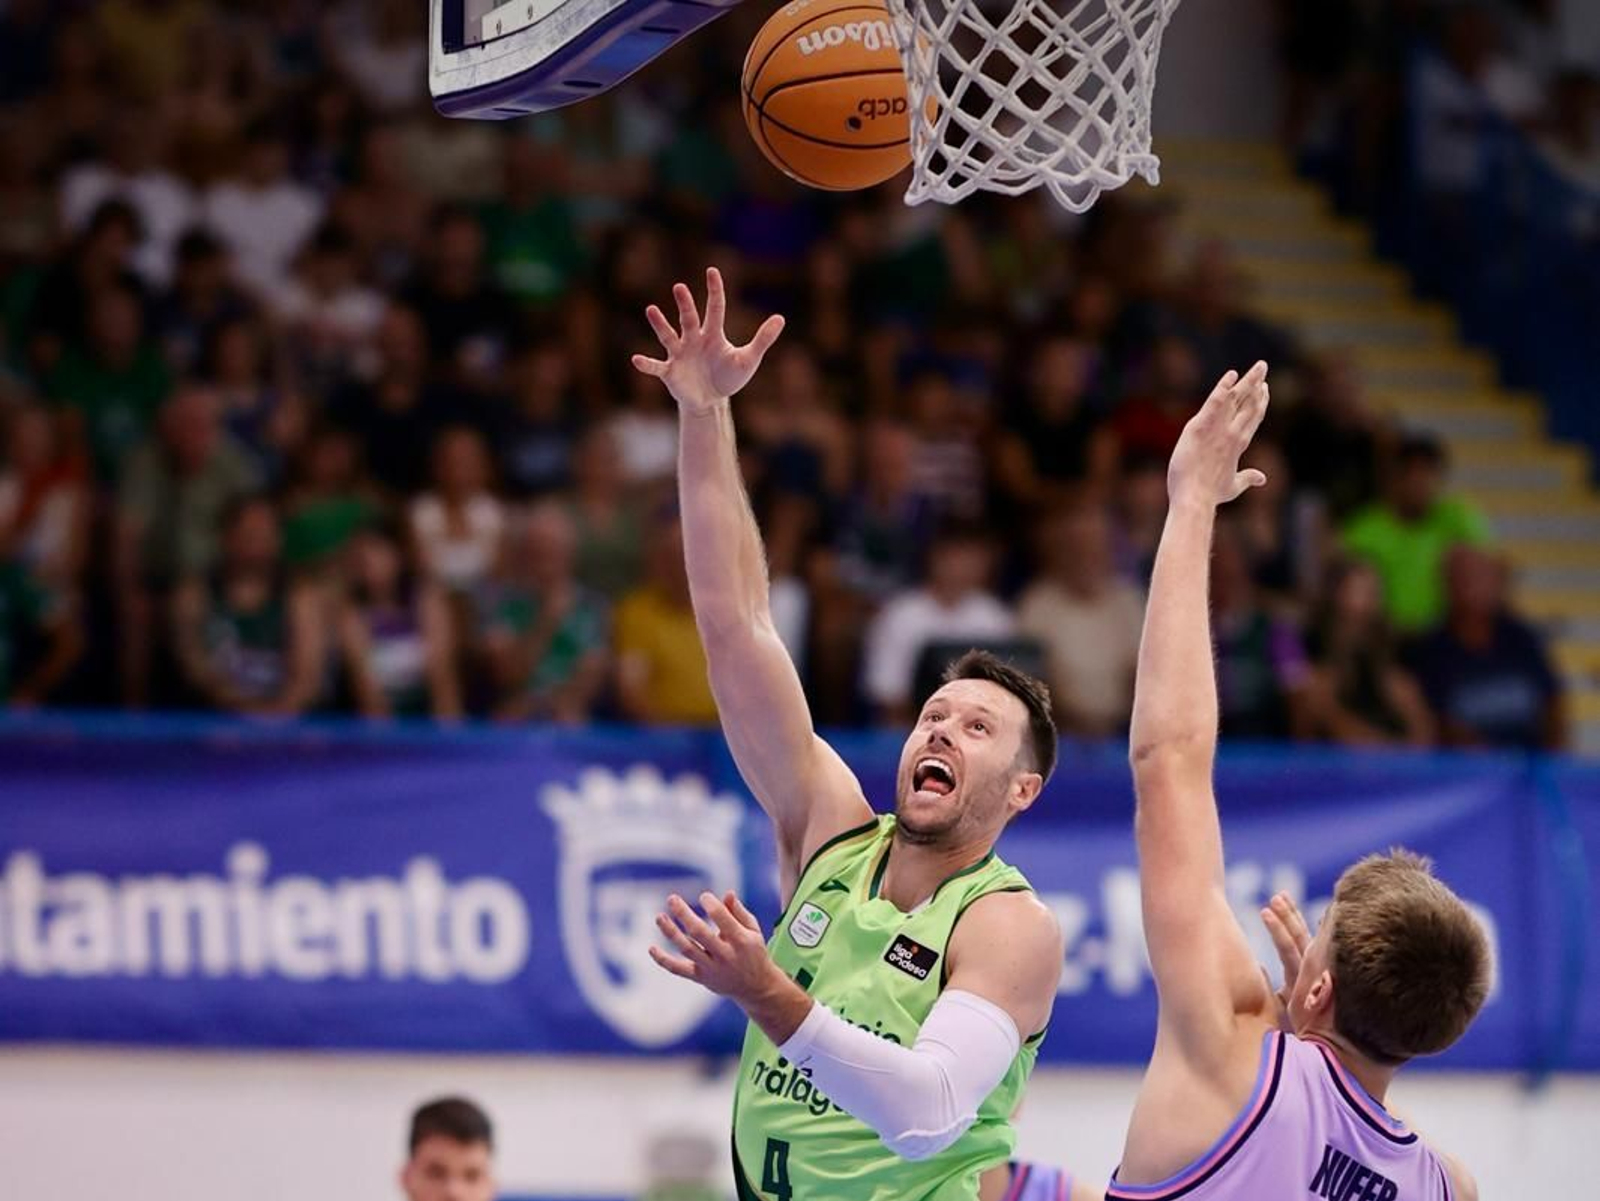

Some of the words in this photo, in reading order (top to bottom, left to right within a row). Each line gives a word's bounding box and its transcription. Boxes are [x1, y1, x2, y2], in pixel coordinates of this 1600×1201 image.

[858, 97, 908, 120] acb
[0, 841, 531, 983] tamiento
[893, 942, 913, 960] liga
